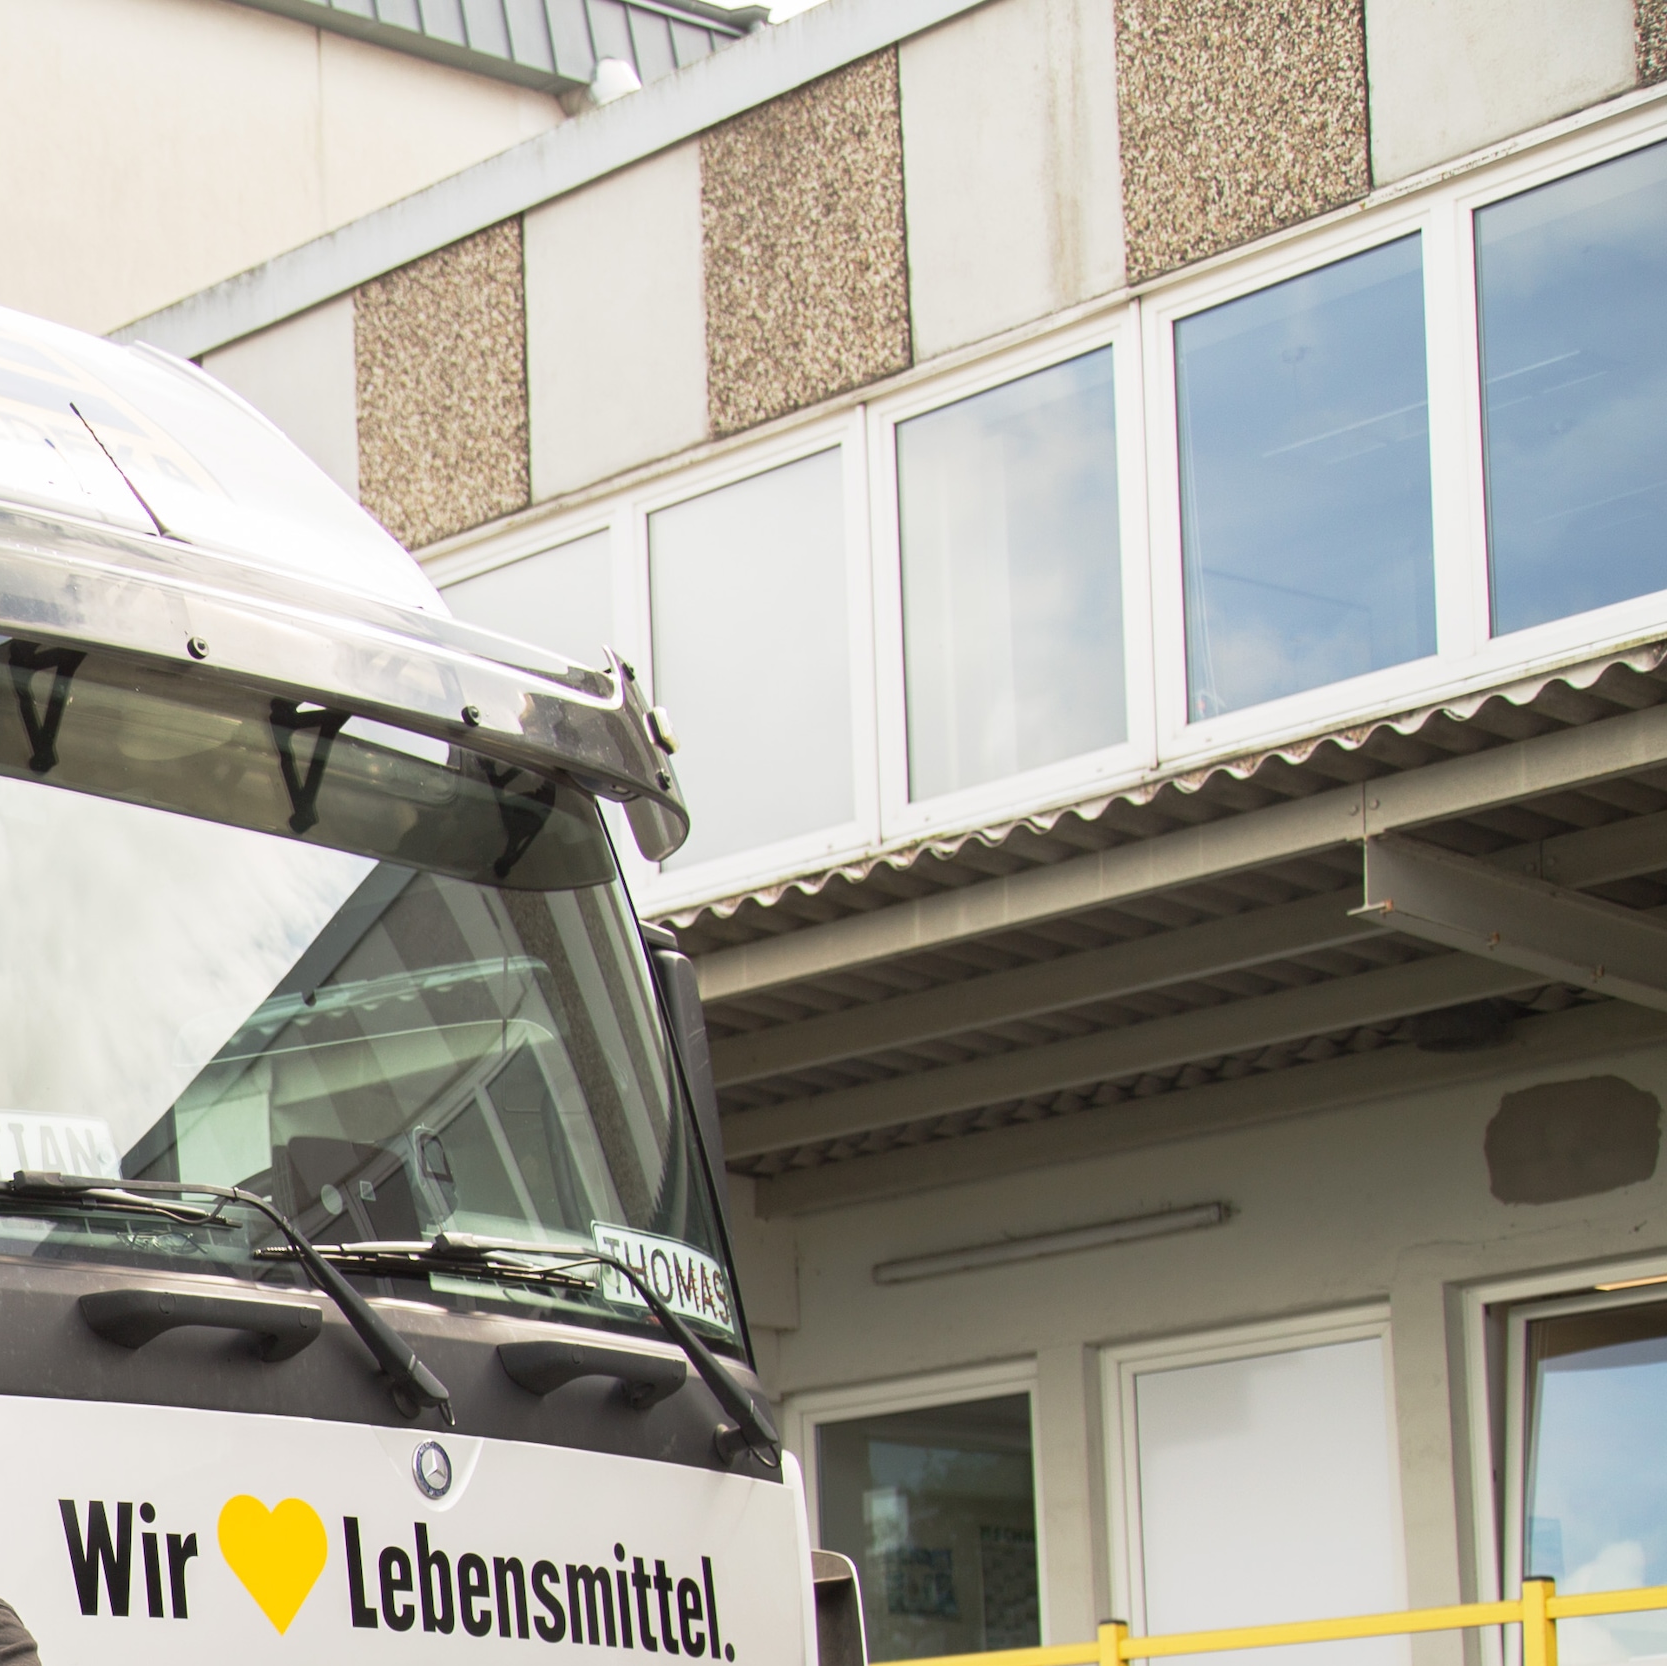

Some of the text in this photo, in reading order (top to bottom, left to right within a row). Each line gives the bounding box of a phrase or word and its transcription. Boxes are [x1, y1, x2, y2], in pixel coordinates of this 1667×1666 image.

[602, 1235, 732, 1326] THOMAS
[57, 1497, 737, 1664] Wir Lebensmittel.
